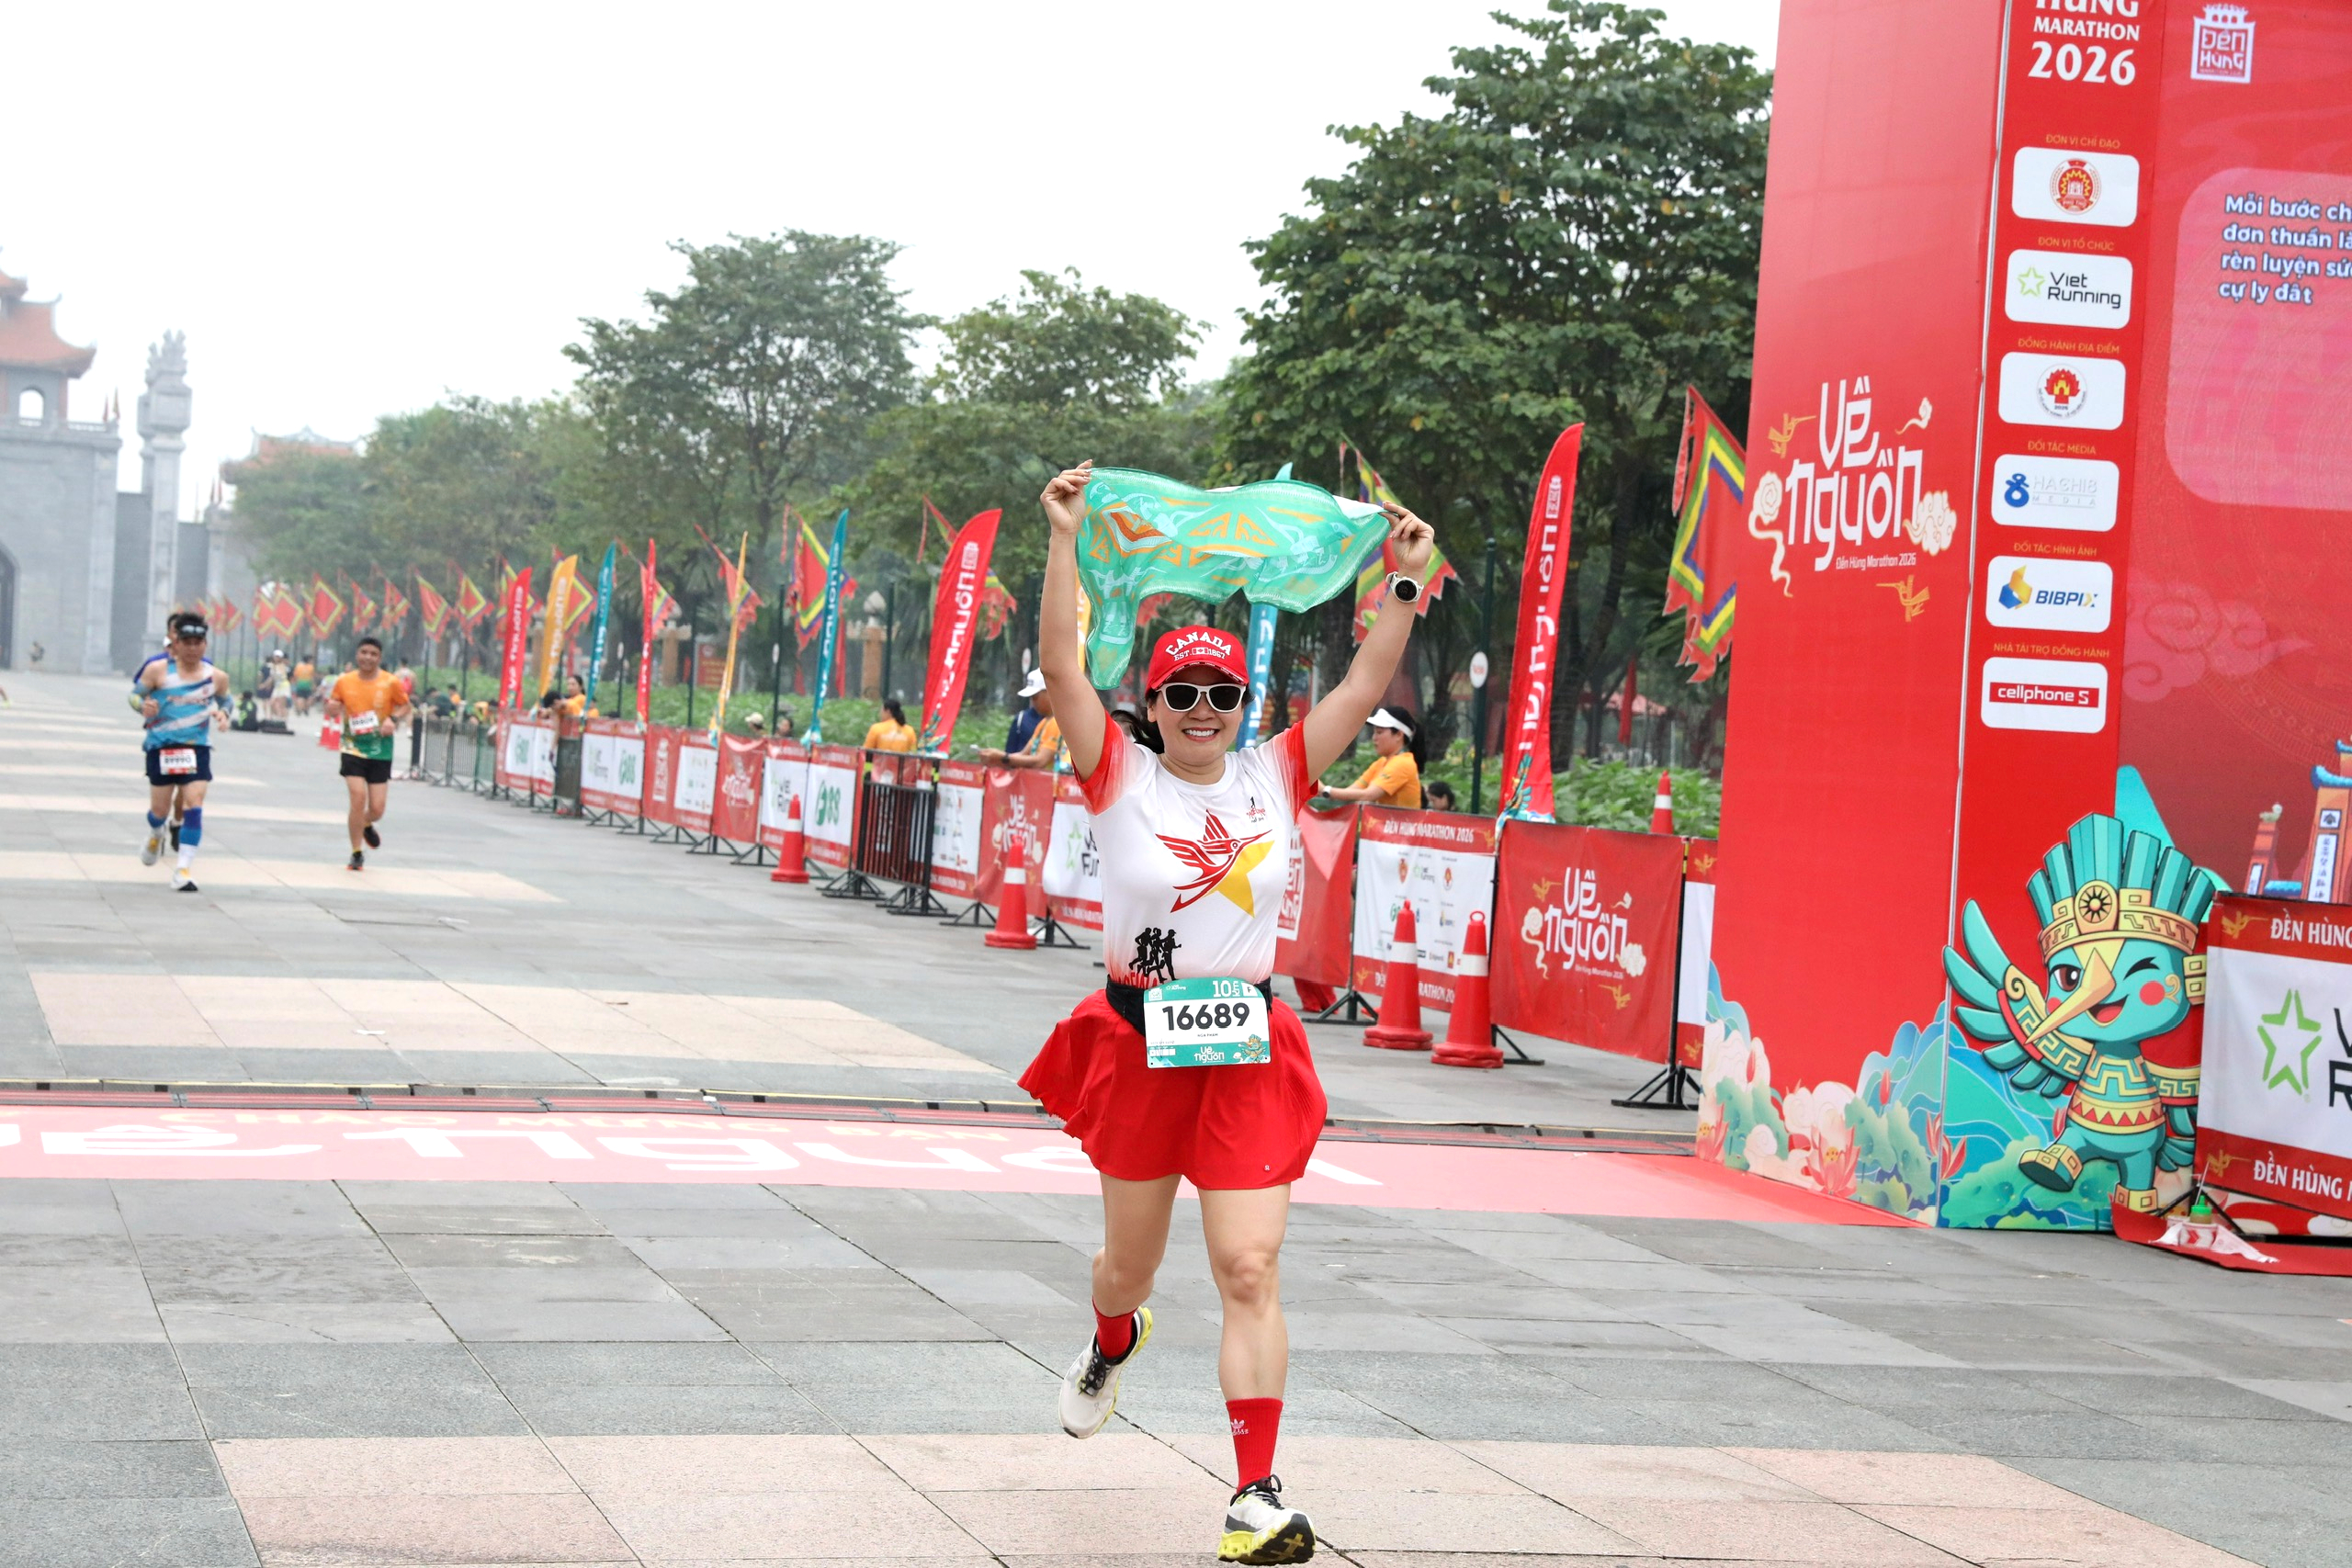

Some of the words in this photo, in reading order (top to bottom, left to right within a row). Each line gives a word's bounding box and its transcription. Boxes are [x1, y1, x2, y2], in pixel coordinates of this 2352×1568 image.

[2033, 16, 2141, 41] MARATHON
[2028, 40, 2136, 86] 2026
[2050, 271, 2088, 288] Viet
[2326, 258, 2352, 277] sứ
[2047, 286, 2121, 310] Running
[2250, 280, 2269, 304] ly
[1165, 631, 1232, 656] CANADA
[1207, 649, 1226, 660] 1867
[2270, 908, 2303, 942] ĐỀN
[1213, 980, 1232, 998] 10
[1161, 1002, 1250, 1031] 16689
[2254, 1150, 2288, 1187] ĐỀN
[2291, 1165, 2343, 1201] HÙNG
